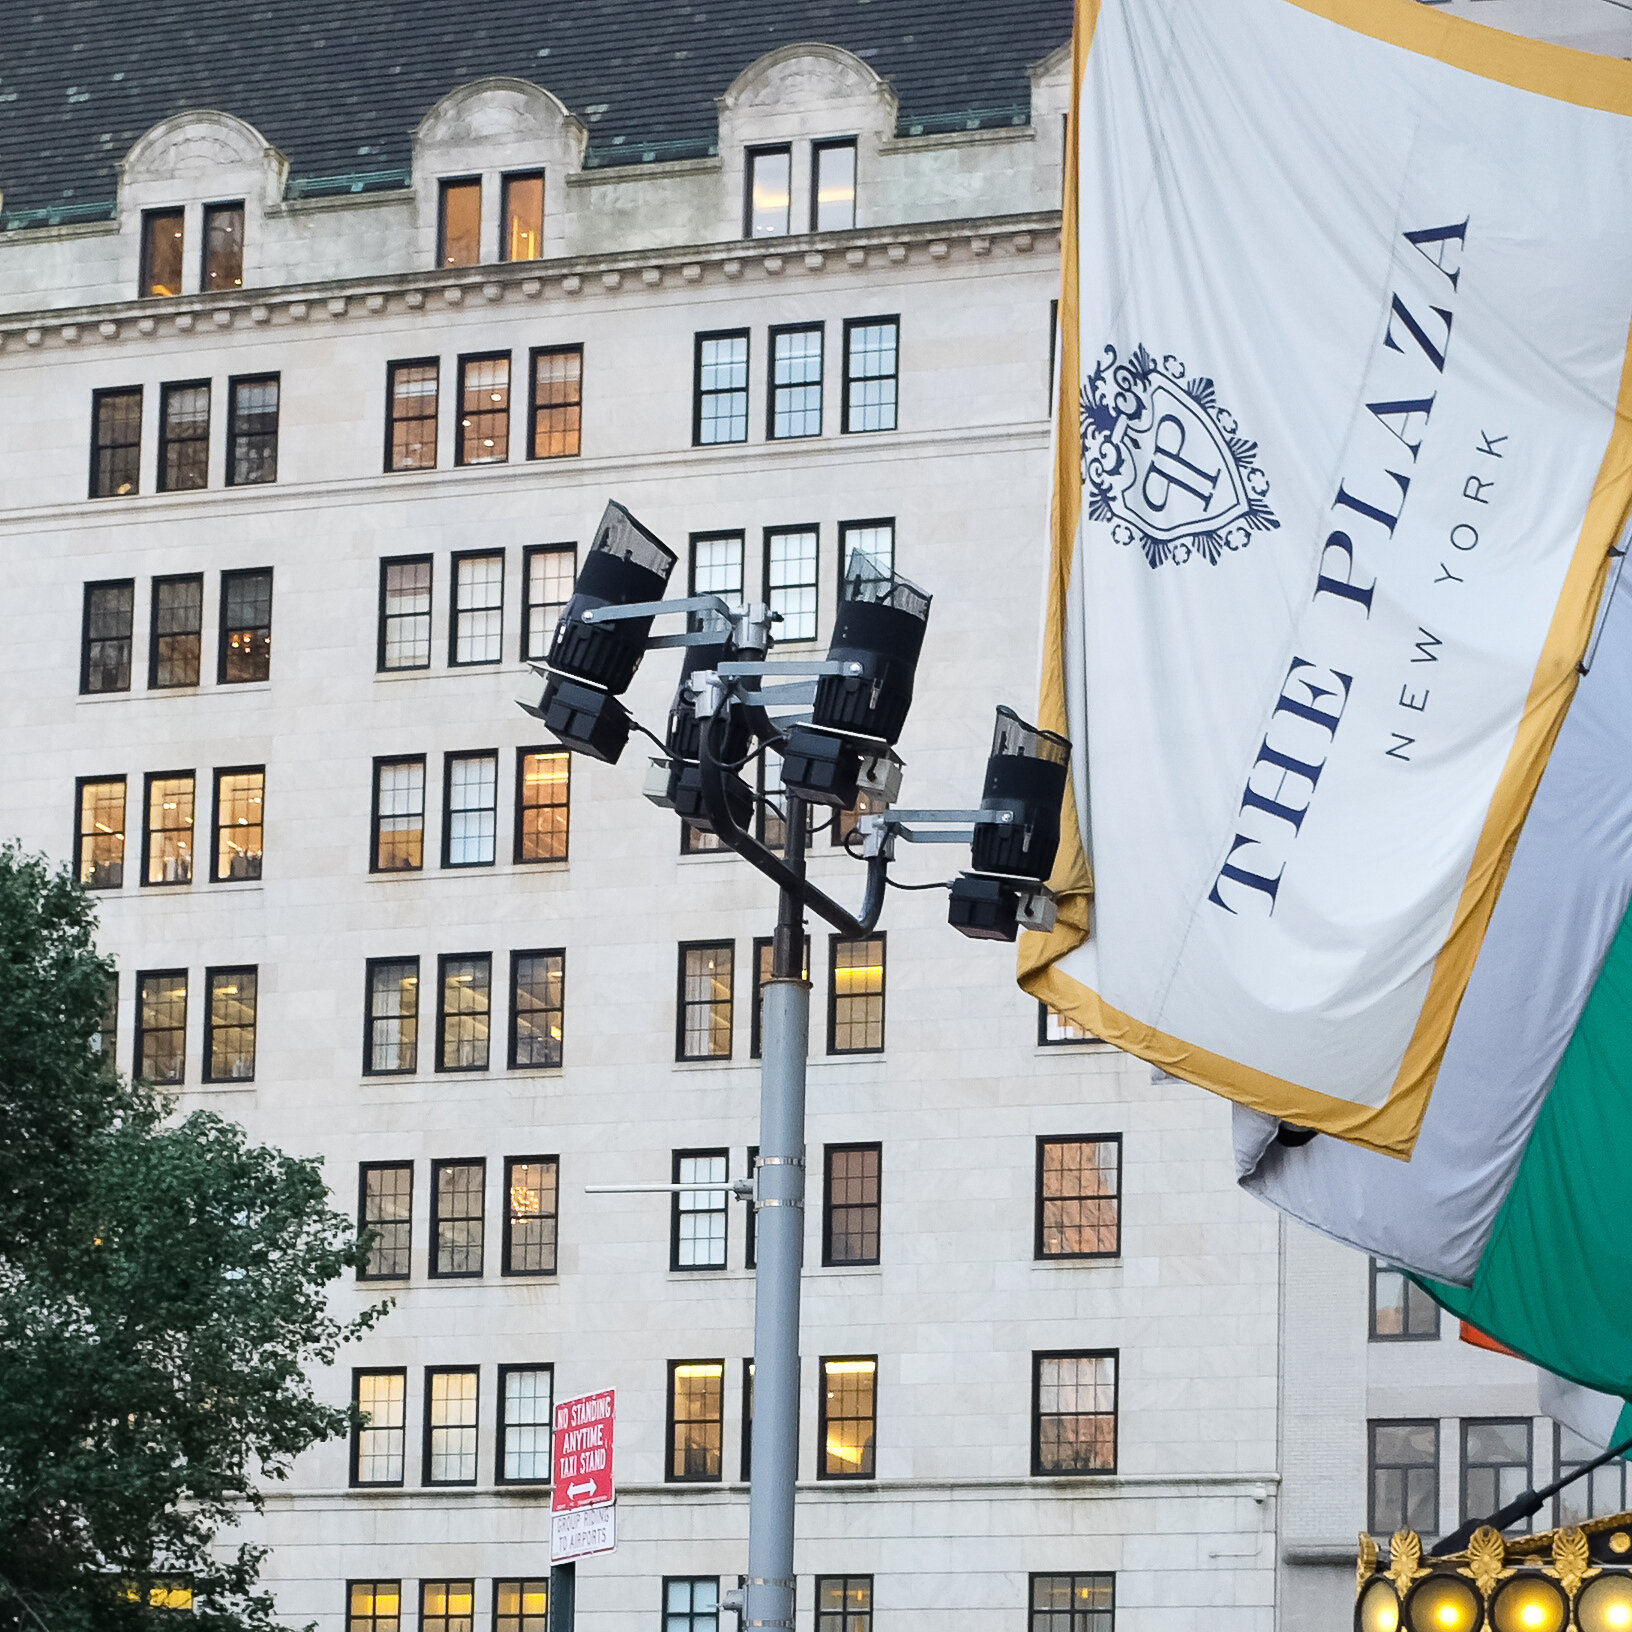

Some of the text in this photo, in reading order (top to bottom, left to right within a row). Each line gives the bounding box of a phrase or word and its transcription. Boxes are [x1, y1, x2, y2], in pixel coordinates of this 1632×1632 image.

[1207, 213, 1471, 918] THE PLAZA
[1385, 428, 1509, 762] NEW YORK
[557, 1396, 611, 1430] NO STANDING
[563, 1424, 604, 1455] ANYTIME
[560, 1448, 606, 1479] TAXI STAND
[569, 1527, 607, 1549] AIRPORTS
